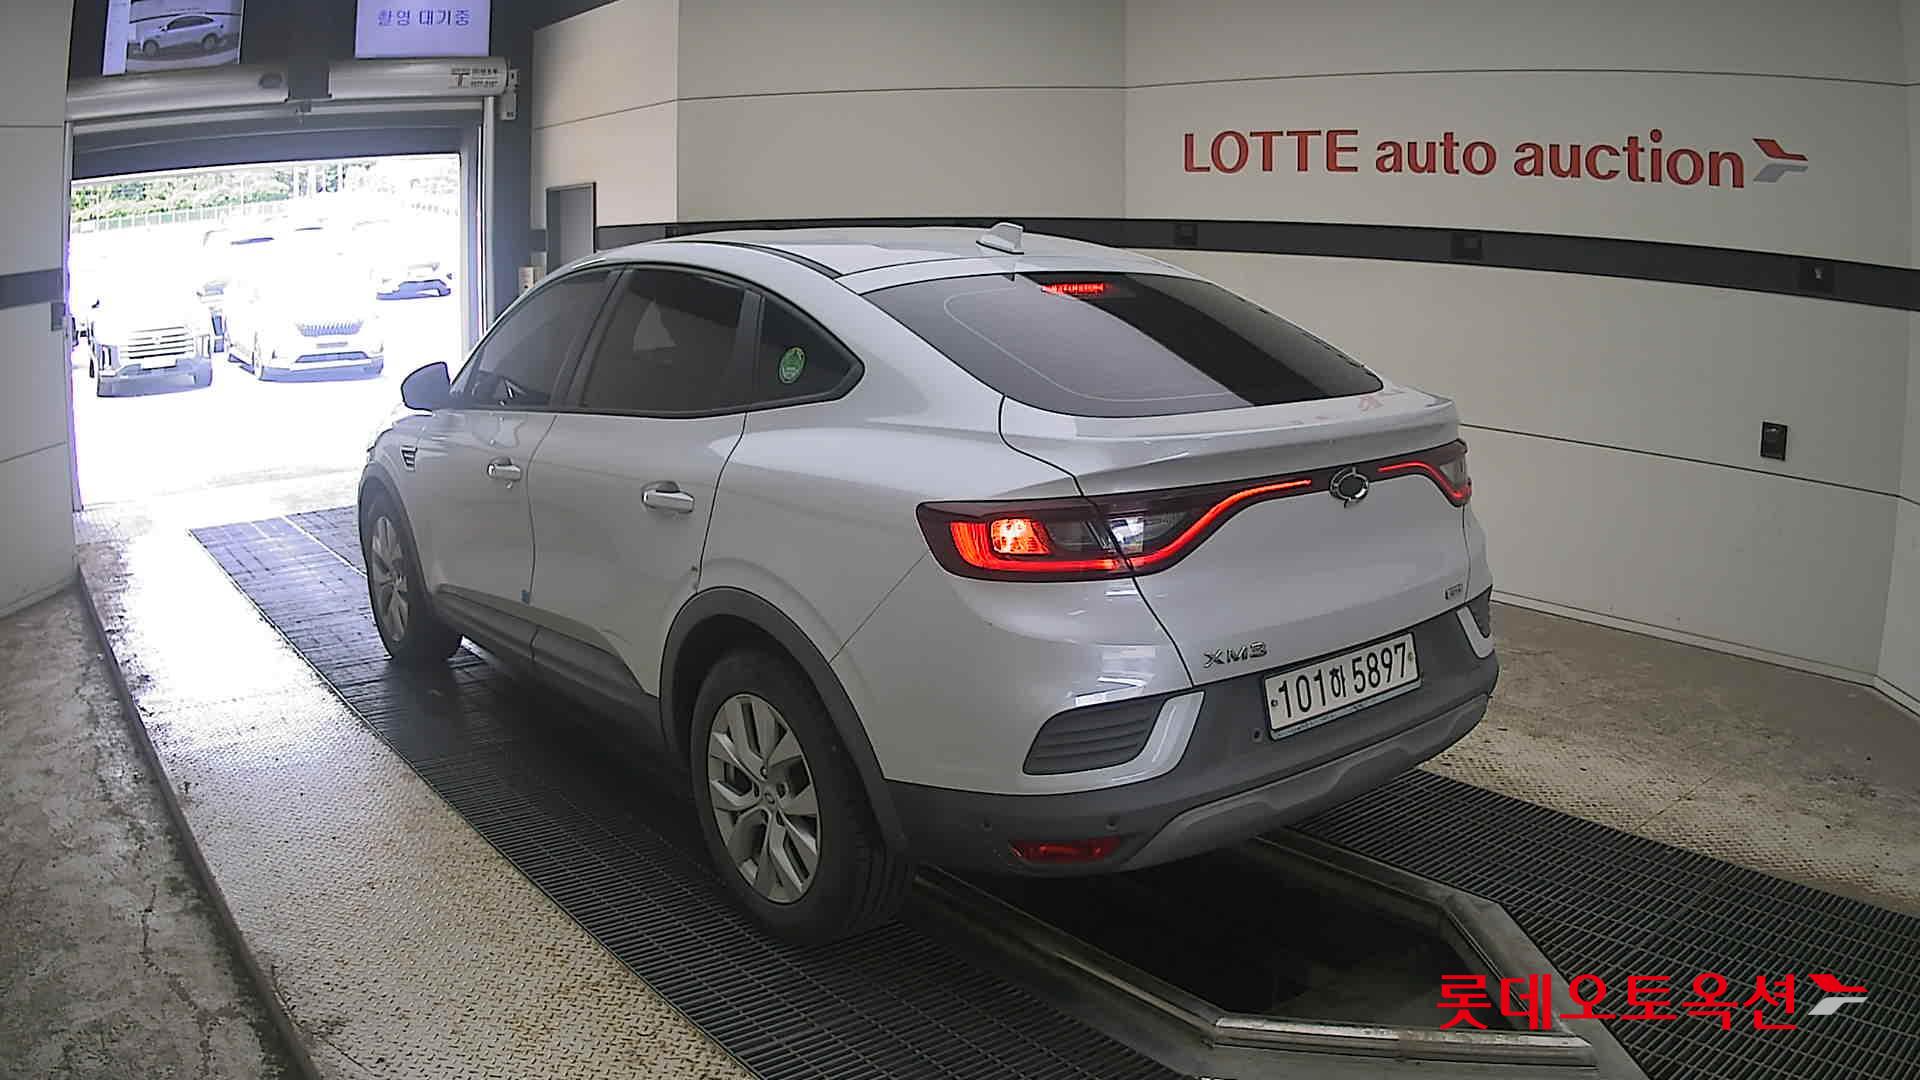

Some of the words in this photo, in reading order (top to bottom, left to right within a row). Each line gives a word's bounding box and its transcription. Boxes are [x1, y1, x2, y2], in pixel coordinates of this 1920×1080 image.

[419, 9, 470, 26] 대기중
[1184, 130, 1359, 173] LOTTE
[1375, 132, 1497, 175] auto
[1514, 129, 1744, 188] auction
[1203, 641, 1267, 668] XM3
[1278, 665, 1347, 718] 101하
[1352, 642, 1406, 694] 5897
